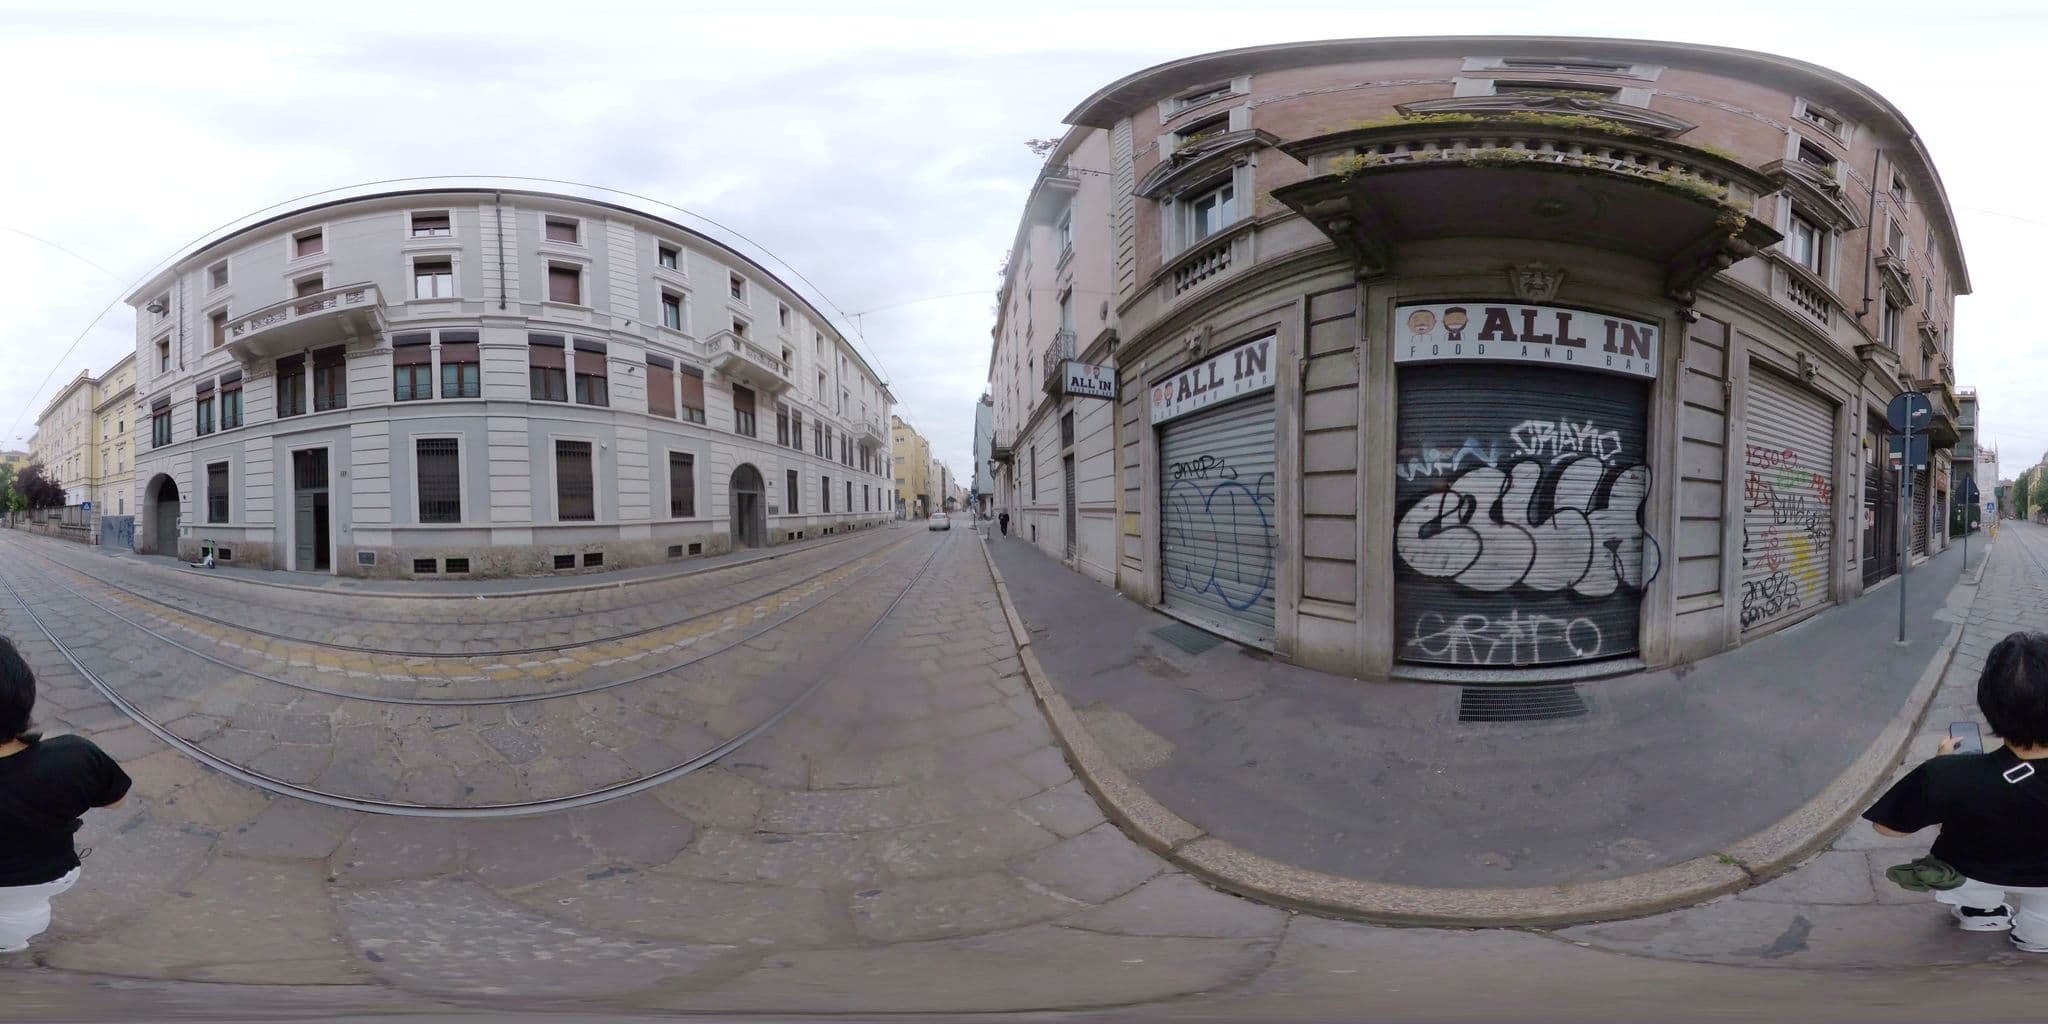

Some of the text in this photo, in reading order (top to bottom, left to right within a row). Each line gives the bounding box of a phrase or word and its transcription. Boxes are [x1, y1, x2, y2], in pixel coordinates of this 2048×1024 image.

[1478, 307, 1653, 360] ALL IN
[1177, 361, 1224, 403] ALL
[1234, 340, 1269, 381] IN
[1410, 343, 1650, 373] FOOD AND BAR
[1071, 376, 1111, 391] ALL IN
